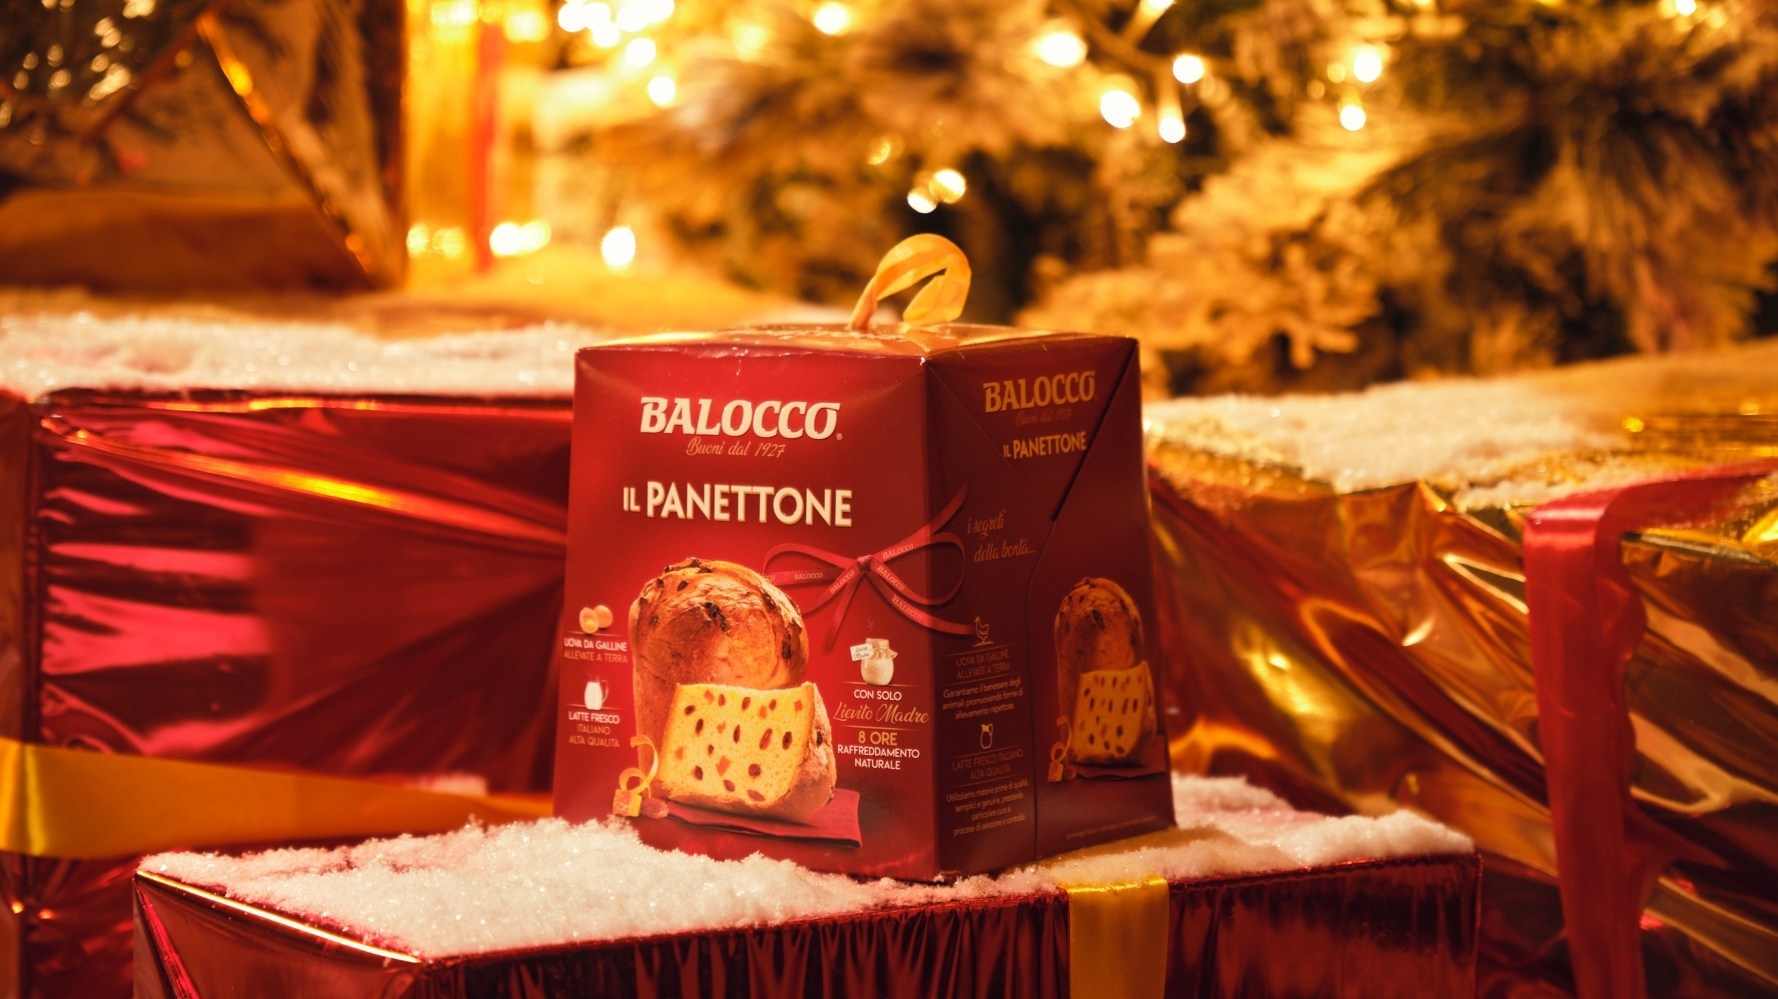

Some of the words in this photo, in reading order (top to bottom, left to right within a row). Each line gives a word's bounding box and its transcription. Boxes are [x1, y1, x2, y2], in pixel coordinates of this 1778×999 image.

[982, 370, 1096, 413] BALOCCO
[640, 396, 841, 440] BALOCCO
[686, 437, 725, 456] Buoni
[727, 441, 752, 456] dal
[754, 443, 787, 458] 1927
[1003, 444, 1012, 458] IL
[1013, 430, 1087, 459] PANETTONE
[623, 487, 641, 511] IL
[647, 481, 852, 527] PANETTONE
[973, 508, 1006, 540] segreti
[881, 544, 914, 559] BALOCCO
[974, 544, 1000, 562] della
[794, 572, 823, 581] BALOCCO
[830, 570, 854, 594] BALOCCO
[876, 565, 904, 591] BALOCCO
[564, 637, 582, 649] UOVA
[583, 639, 594, 649] DA
[595, 640, 628, 652] GALLINE
[563, 650, 595, 661] ALLEVATE
[596, 653, 602, 662] A
[604, 653, 628, 663] TERRA
[976, 654, 985, 664] DA
[854, 689, 874, 699] CON
[876, 691, 902, 701] SOLO
[568, 711, 590, 722] LATTE
[591, 713, 620, 724] FRESCO
[833, 701, 873, 721] Lievito
[876, 703, 930, 724] Madre
[577, 723, 611, 735] ITALIANO
[569, 735, 586, 745] ALTA
[858, 731, 866, 743] 8
[870, 731, 898, 746] ORE
[837, 744, 920, 759] RAFFREDDAMENTO
[854, 758, 901, 770] NATURALE
[952, 759, 973, 771] LATTE
[973, 754, 997, 767] FRESCO
